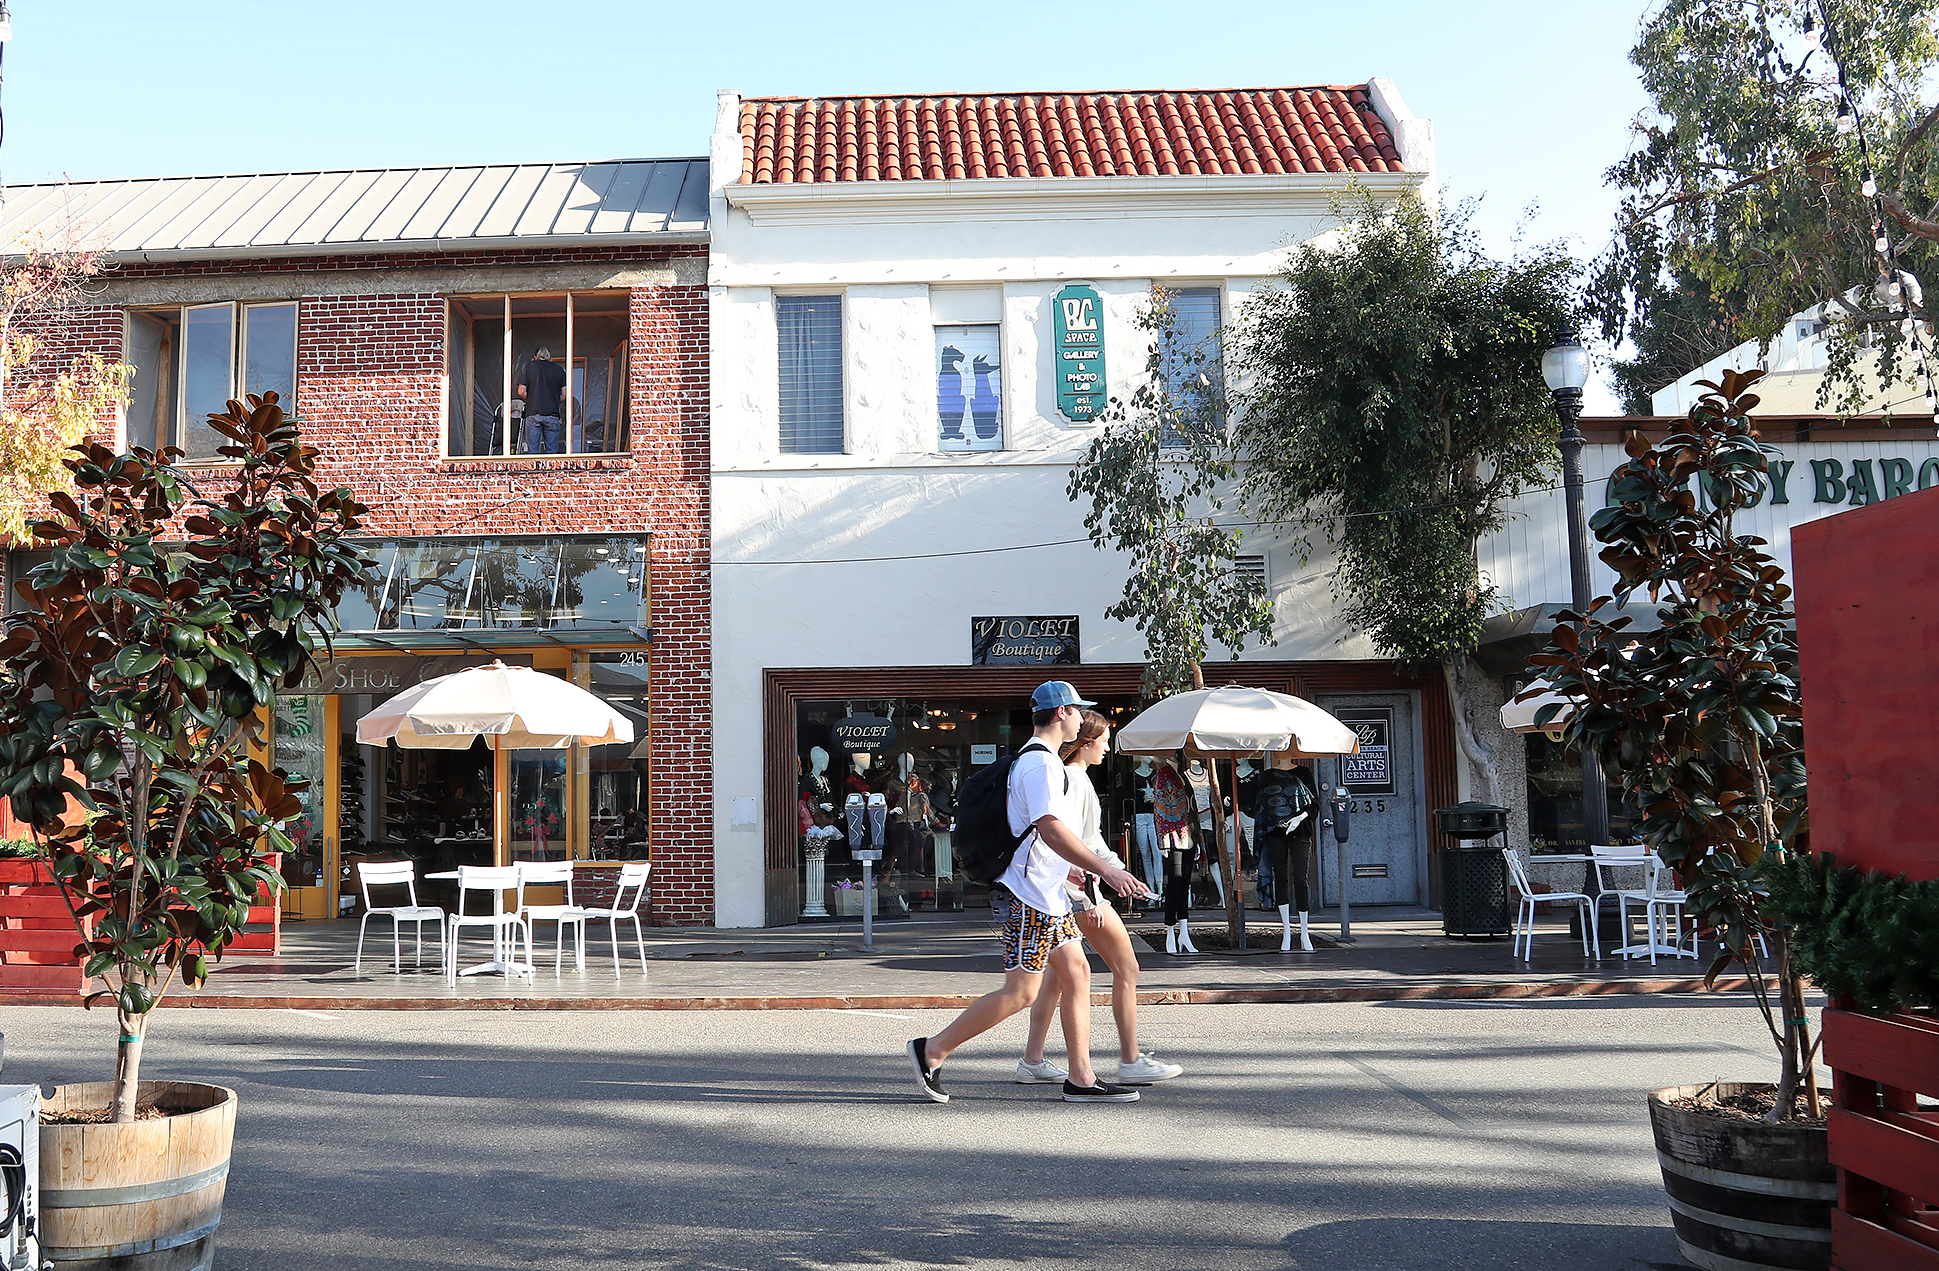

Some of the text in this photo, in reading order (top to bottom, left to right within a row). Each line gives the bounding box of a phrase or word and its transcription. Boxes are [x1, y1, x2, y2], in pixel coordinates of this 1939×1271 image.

[1061, 298, 1099, 331] BC
[1064, 332, 1098, 343] SPACE
[1062, 350, 1100, 360] GALLERY
[1078, 362, 1086, 371] &
[1066, 373, 1098, 382] PHOTO
[1073, 382, 1091, 391] LAB
[1076, 396, 1092, 404] est.
[1074, 405, 1093, 414] 1973
[975, 616, 1077, 639] VIOLET
[991, 641, 1062, 661] Boutique
[620, 651, 645, 667] 245
[334, 663, 400, 689] SHOE
[836, 725, 891, 738] VIOLET
[842, 739, 881, 750] Boutique
[1346, 759, 1386, 771] ARTS
[1346, 771, 1386, 779] CENTER
[1350, 800, 1386, 814] 235
